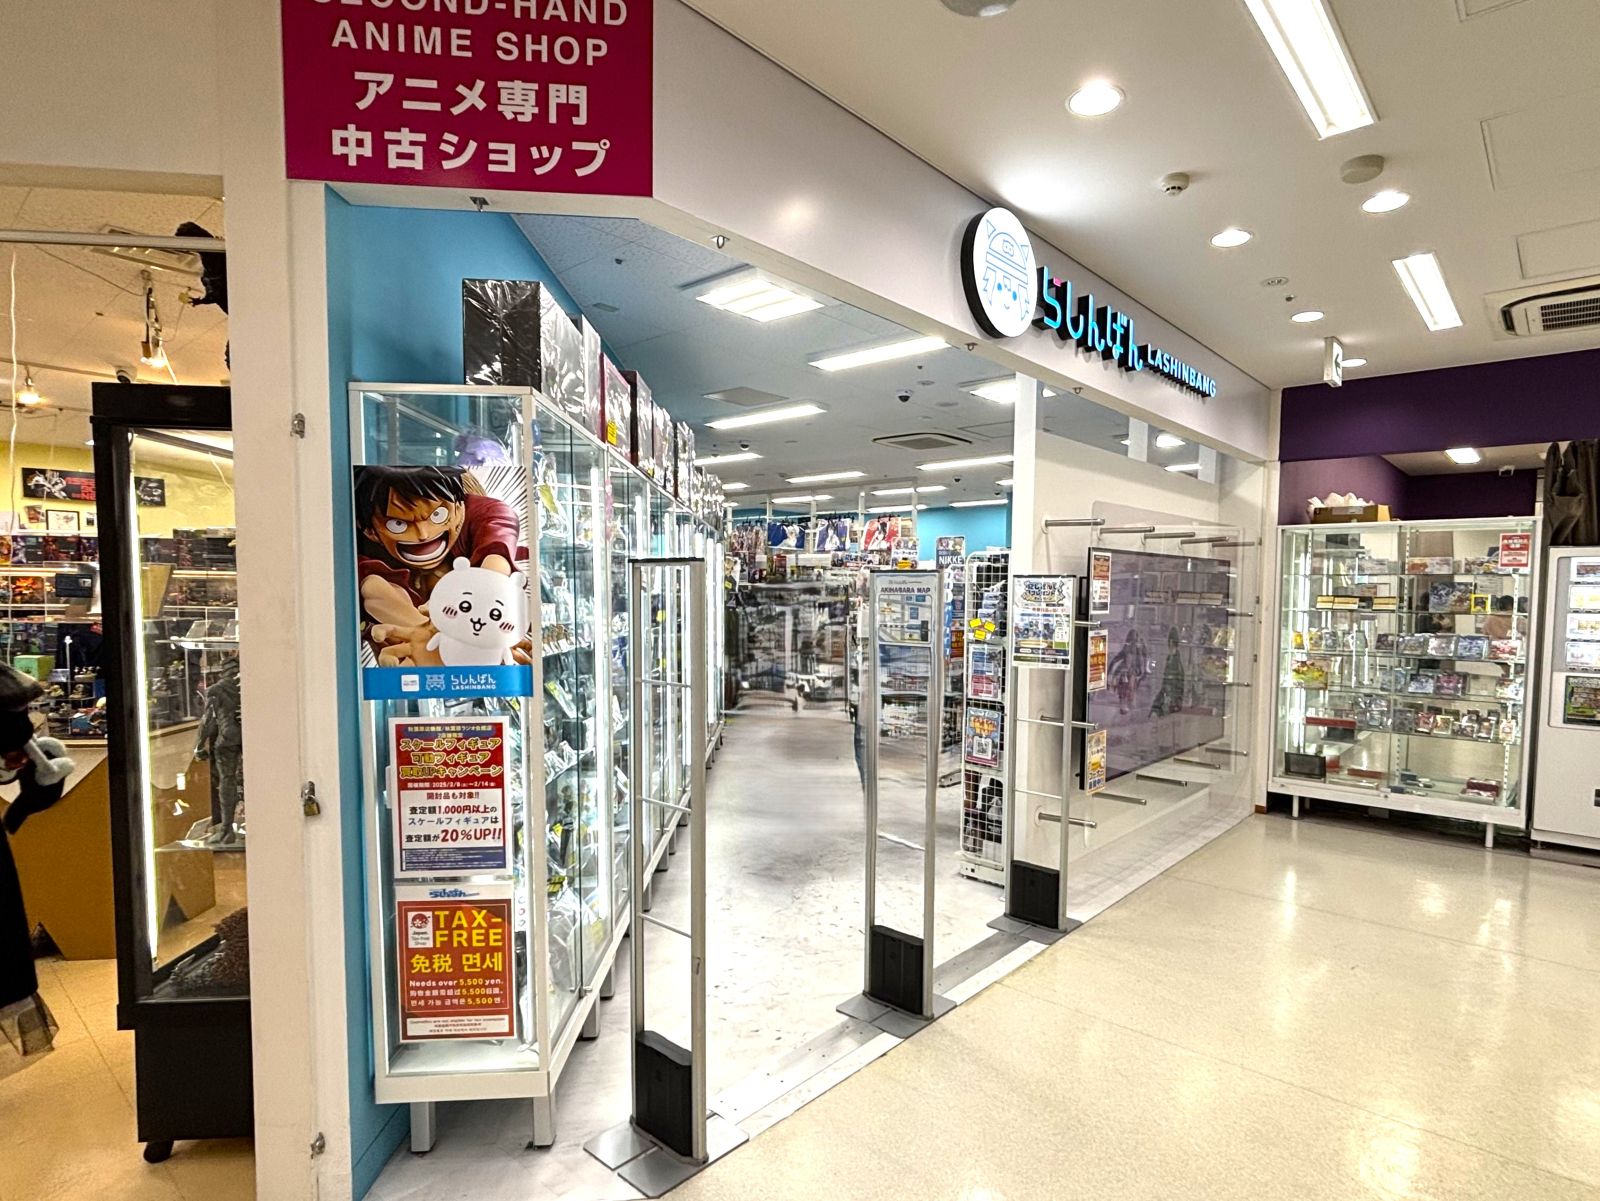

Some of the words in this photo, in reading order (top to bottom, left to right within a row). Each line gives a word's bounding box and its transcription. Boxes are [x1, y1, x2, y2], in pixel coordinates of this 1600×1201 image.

[332, 20, 473, 58] ANIME
[496, 31, 608, 66] SHOP
[354, 71, 588, 126] アニメ専門
[331, 123, 611, 177] 中古ショップ
[1042, 265, 1143, 372] らしんばん
[1147, 343, 1217, 398] LASHINBANG
[938, 554, 963, 565] NIKKE
[880, 586, 915, 594] AKIHABARA
[917, 586, 931, 594] MAP
[451, 674, 496, 684] らしんばん
[400, 737, 502, 751] スケールフィギュア
[411, 751, 491, 765] 可動フィギュア
[408, 816, 500, 827] スケールフィギュアは
[434, 909, 503, 929] TAX-
[435, 928, 503, 949] FREE
[410, 953, 453, 974] 免税
[462, 952, 503, 973] 면세
[459, 978, 484, 986] 5,500
